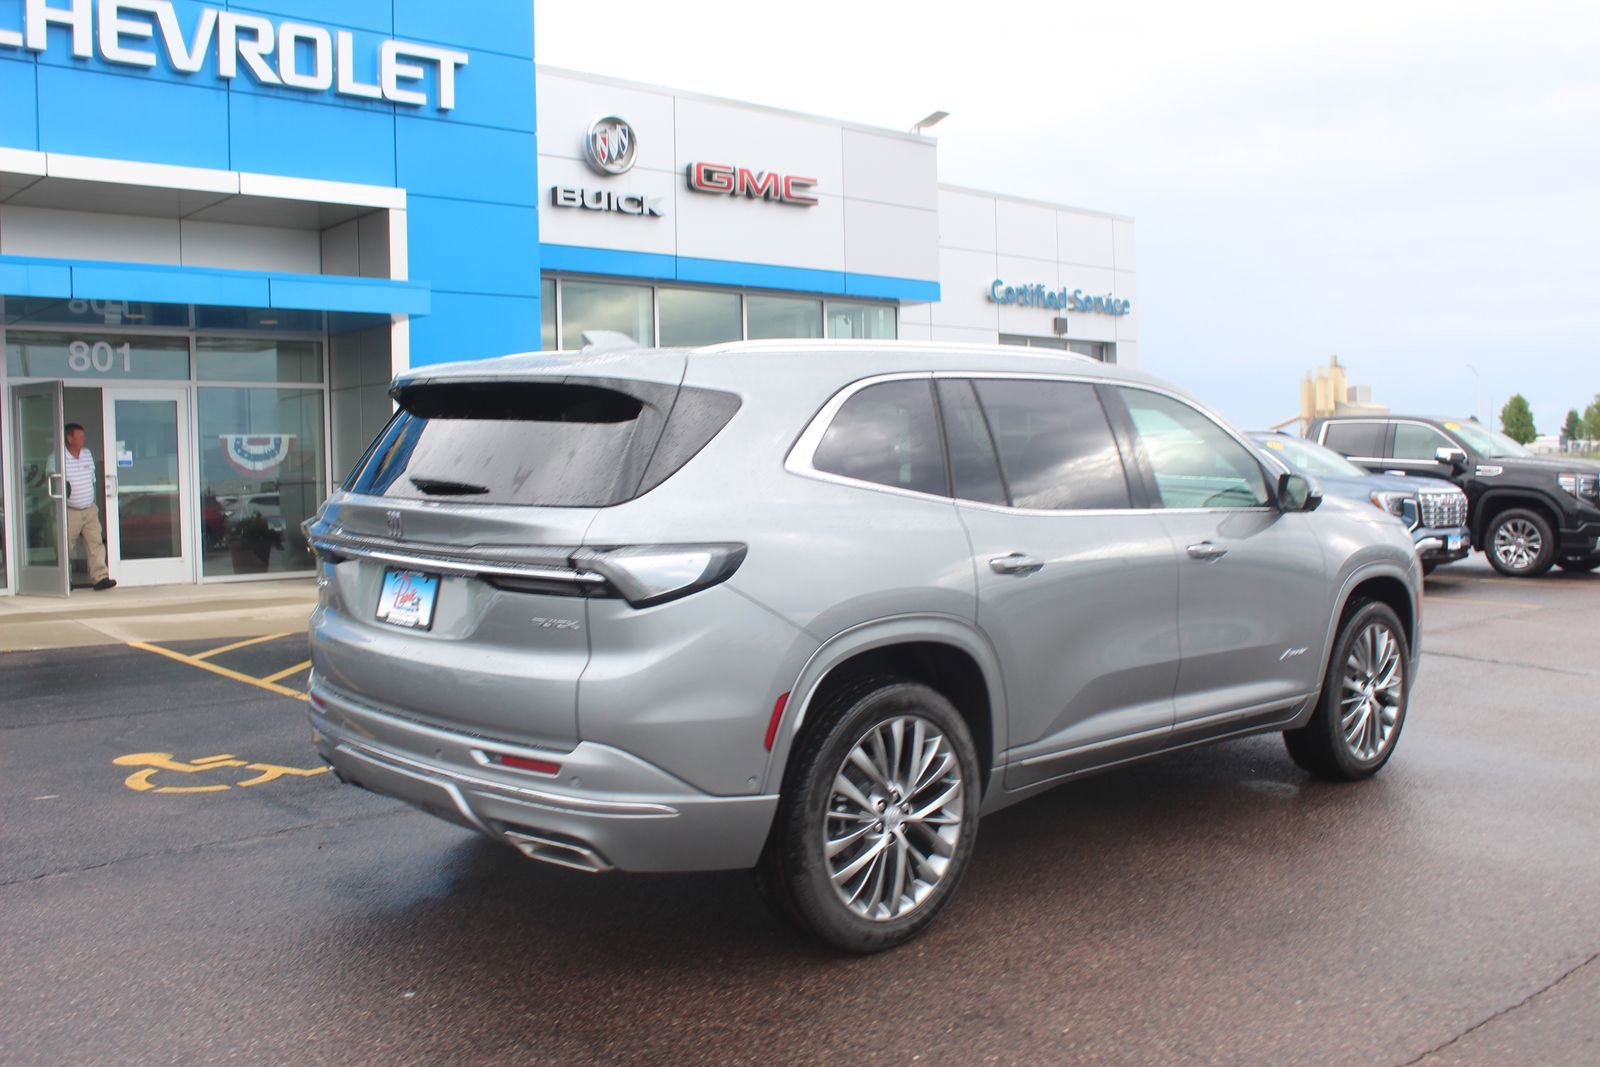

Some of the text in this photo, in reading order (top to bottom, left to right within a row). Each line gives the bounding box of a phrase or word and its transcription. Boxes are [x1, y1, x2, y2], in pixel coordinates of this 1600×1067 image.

[0, 0, 469, 111] HEVROLET
[552, 185, 666, 218] BUICK
[688, 161, 819, 206] GMC
[988, 278, 1131, 316] Certified Service
[68, 340, 131, 372] 801
